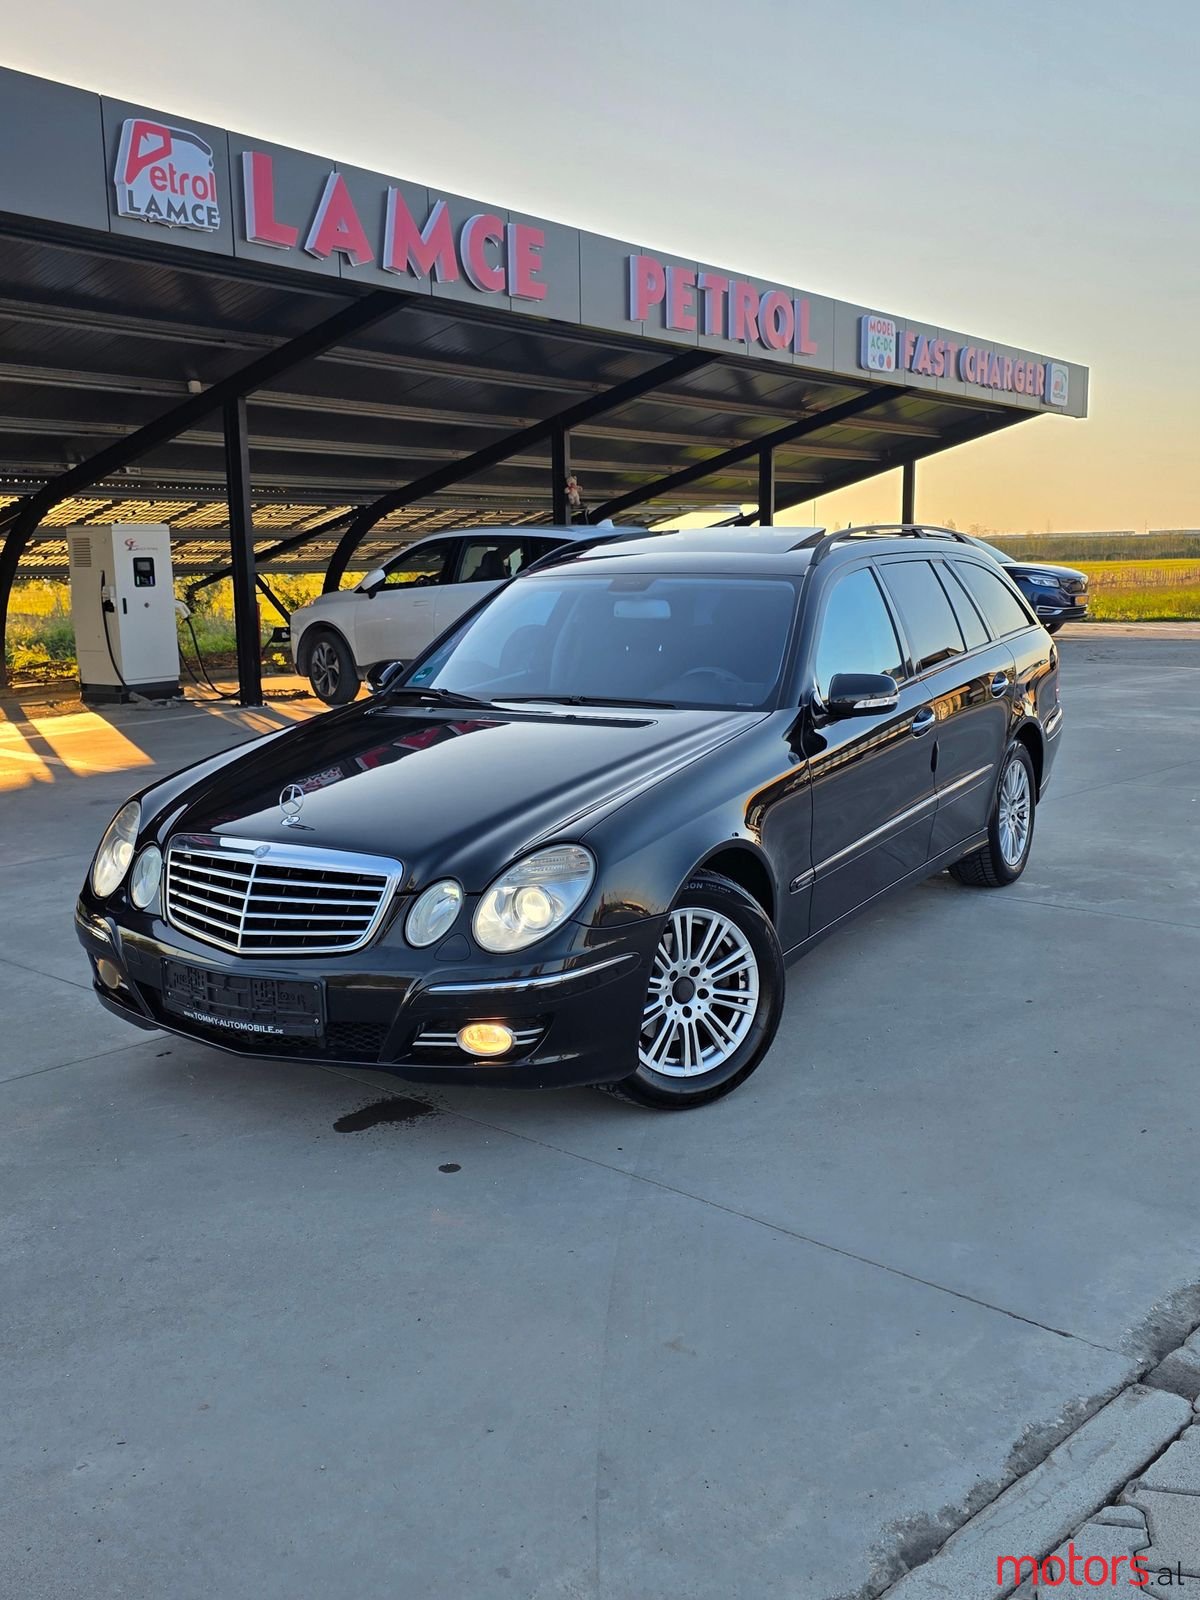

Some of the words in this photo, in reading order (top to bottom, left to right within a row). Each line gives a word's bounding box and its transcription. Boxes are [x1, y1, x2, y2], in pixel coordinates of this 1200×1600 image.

[125, 120, 216, 203] Petrol
[127, 189, 218, 227] LAMCE
[243, 151, 547, 301] LAMCE
[630, 254, 817, 355] PETROL
[869, 320, 894, 337] MODEL
[870, 336, 893, 353] AC-DC
[899, 330, 959, 379] FAST
[960, 344, 1045, 397] CHARGER
